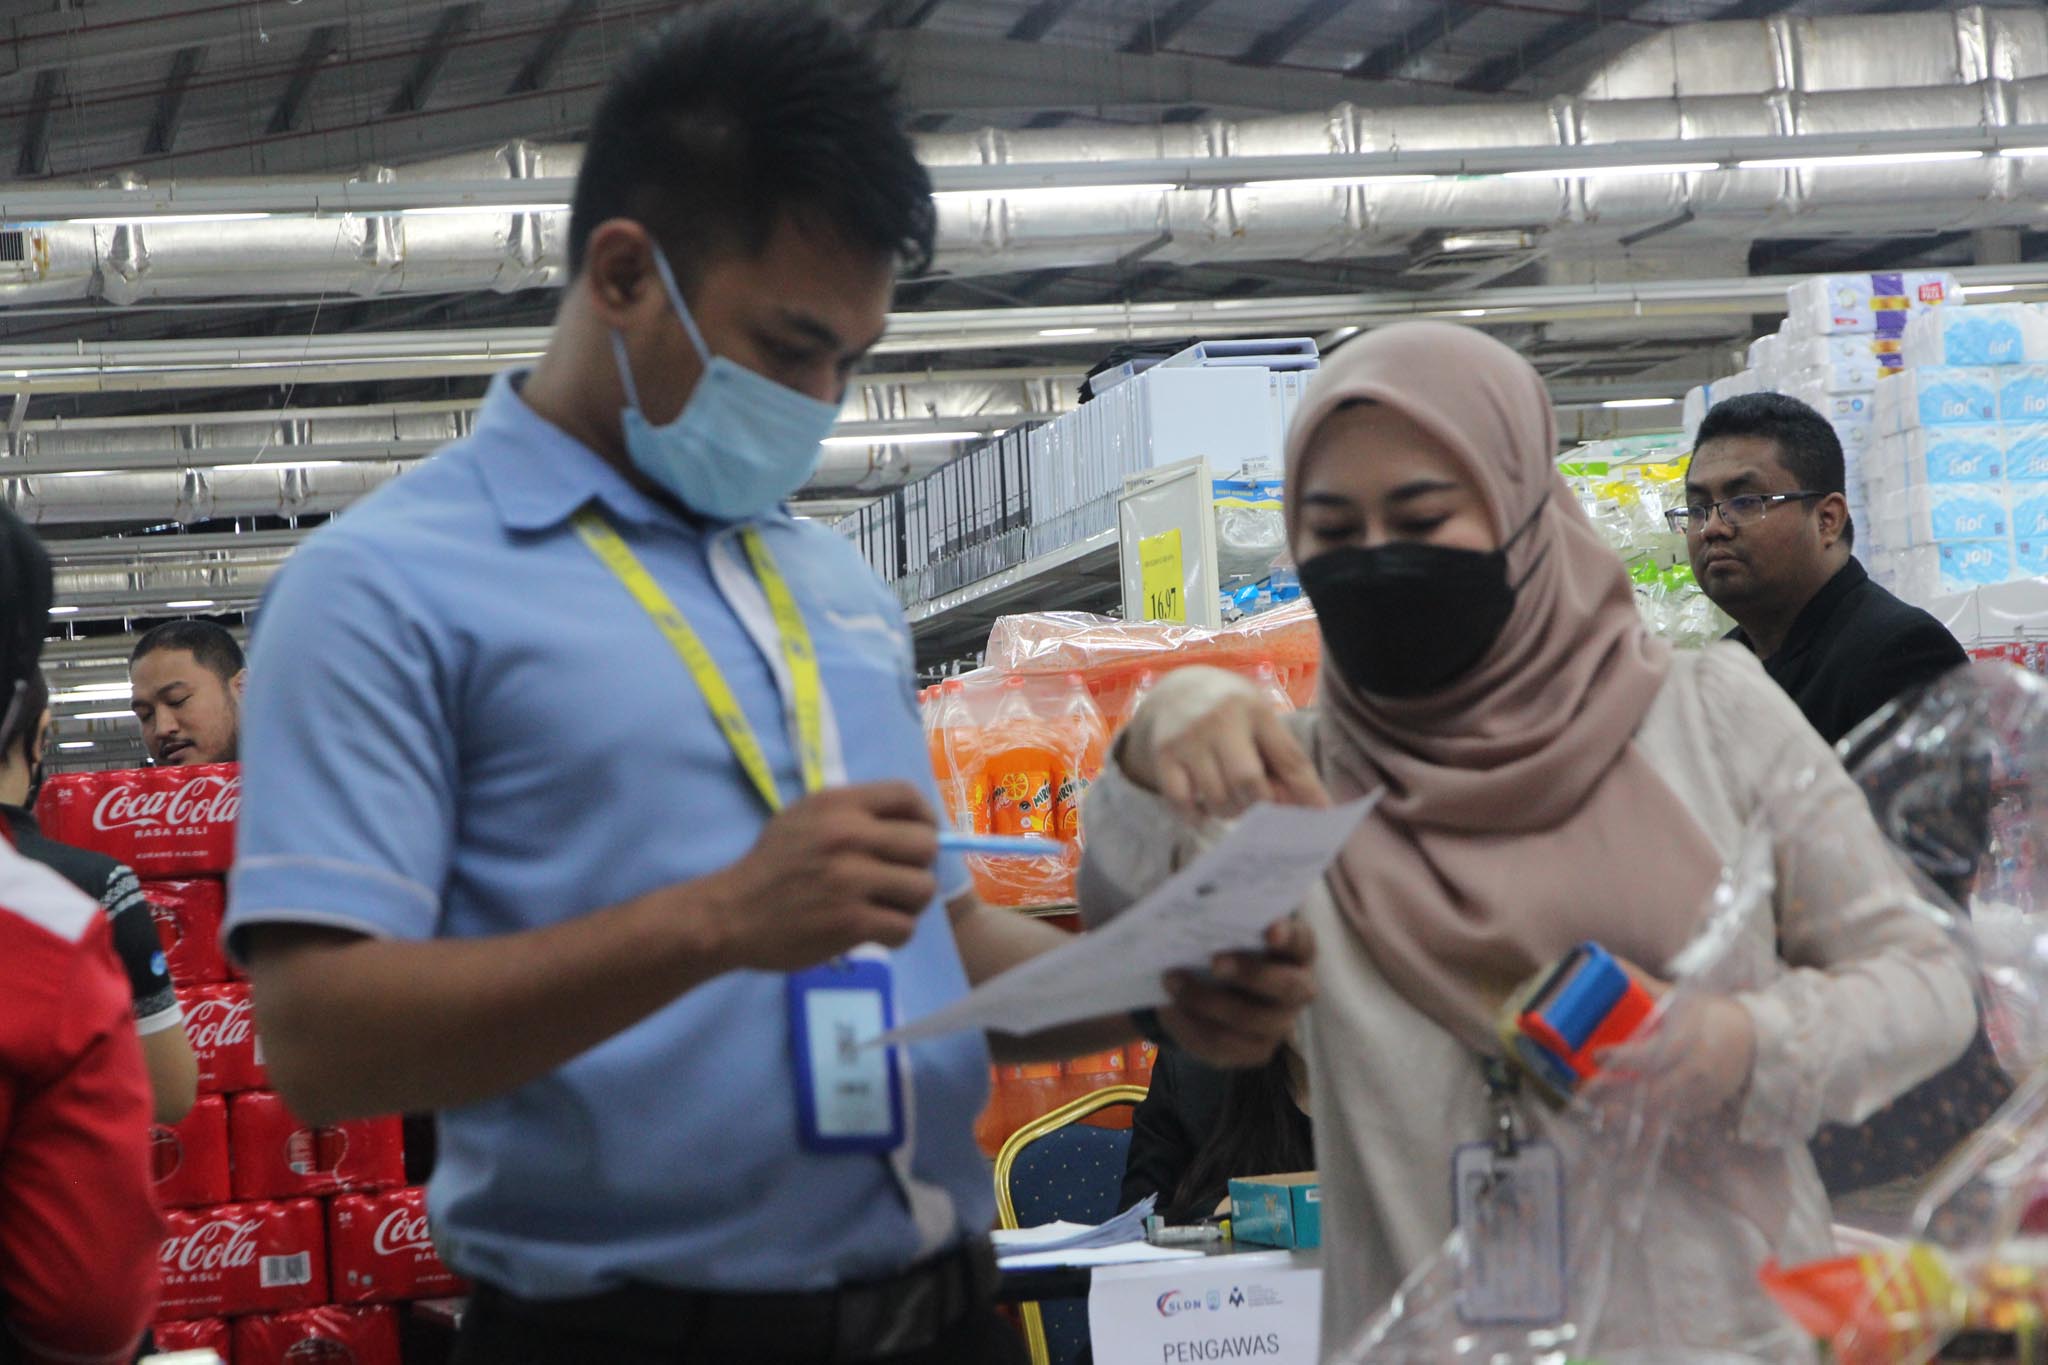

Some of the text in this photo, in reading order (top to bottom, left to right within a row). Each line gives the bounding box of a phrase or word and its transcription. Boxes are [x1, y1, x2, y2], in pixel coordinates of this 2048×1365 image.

[92, 775, 242, 831] Coca-Cola
[134, 826, 208, 838] RASA ASLI
[189, 1271, 222, 1282] ASLI
[1163, 1333, 1280, 1364] PENGAWAS
